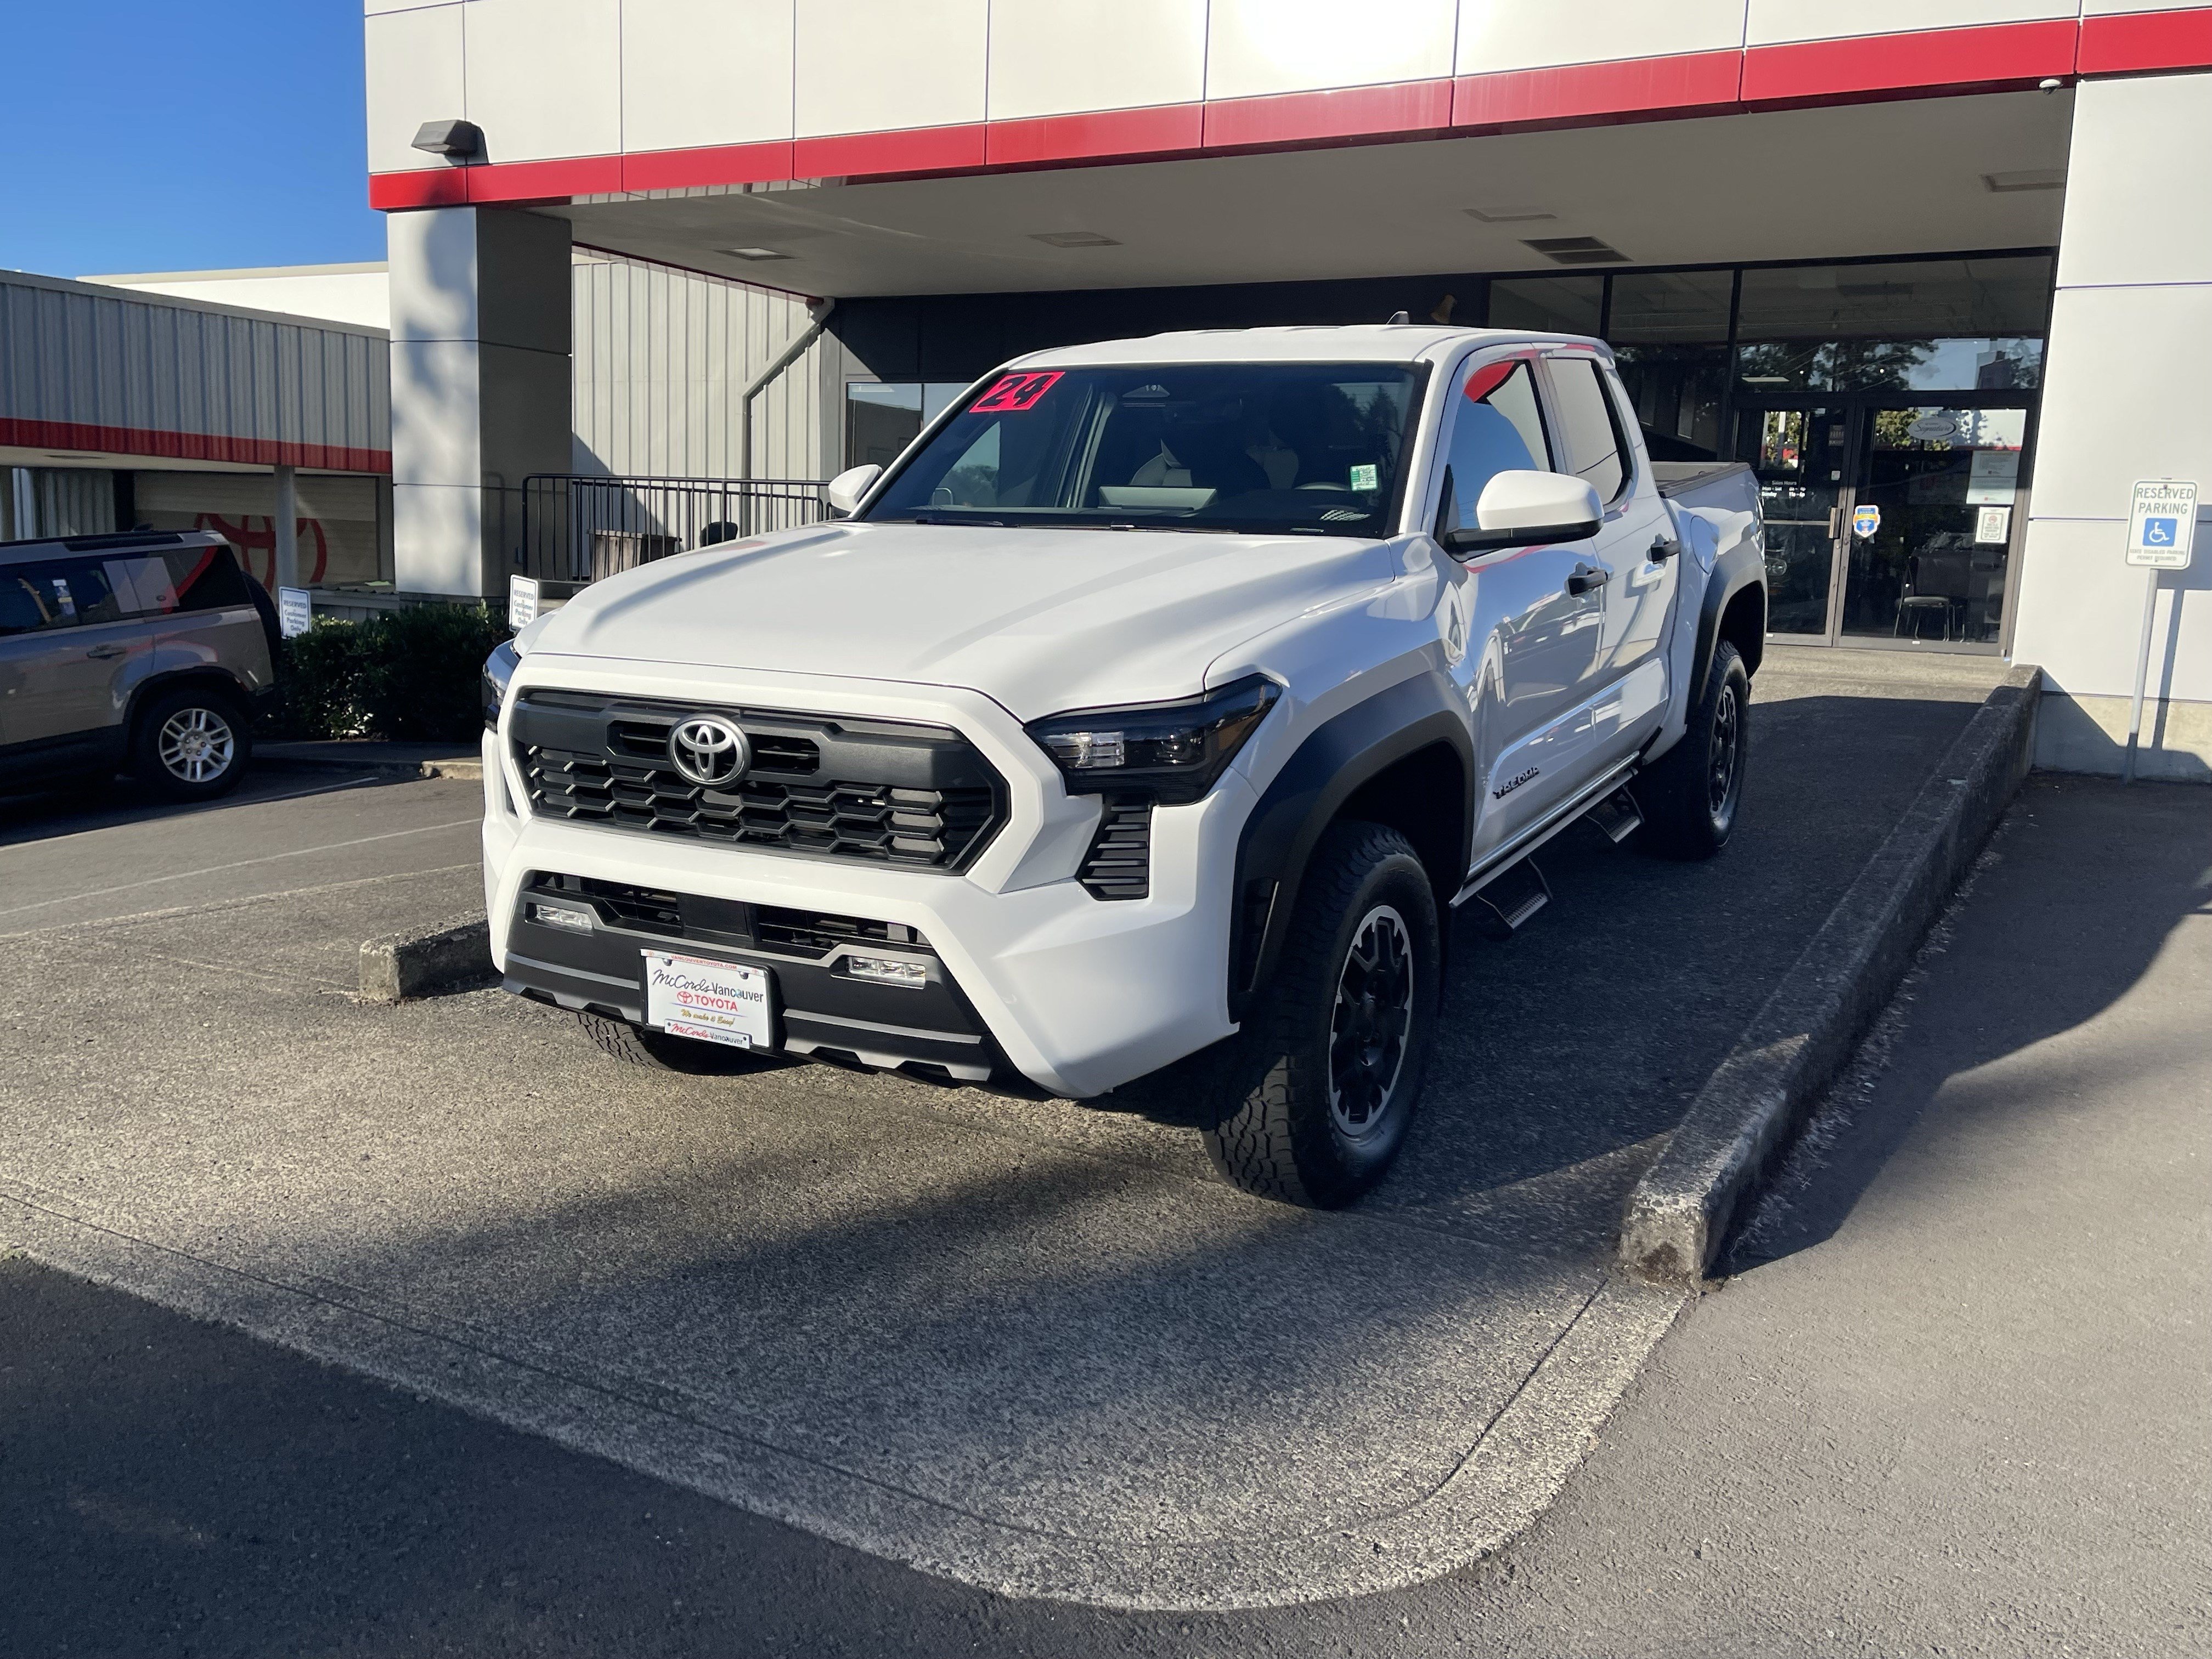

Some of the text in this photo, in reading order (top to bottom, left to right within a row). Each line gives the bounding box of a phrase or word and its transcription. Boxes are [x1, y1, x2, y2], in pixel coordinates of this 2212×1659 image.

[977, 374, 1054, 409] 24
[2136, 487, 2194, 500] RESERVED
[2138, 503, 2188, 515] PARKING
[514, 589, 534, 600] RESERVED
[283, 600, 307, 609] RESERVED
[514, 600, 533, 611] Customer
[284, 609, 307, 618] Customer
[515, 608, 532, 620] Parking
[286, 617, 305, 627] Parking
[518, 617, 528, 625] Only
[670, 955, 737, 969] VANCOUVERTOYOTA.COM
[694, 994, 738, 1012] TOYOTA
